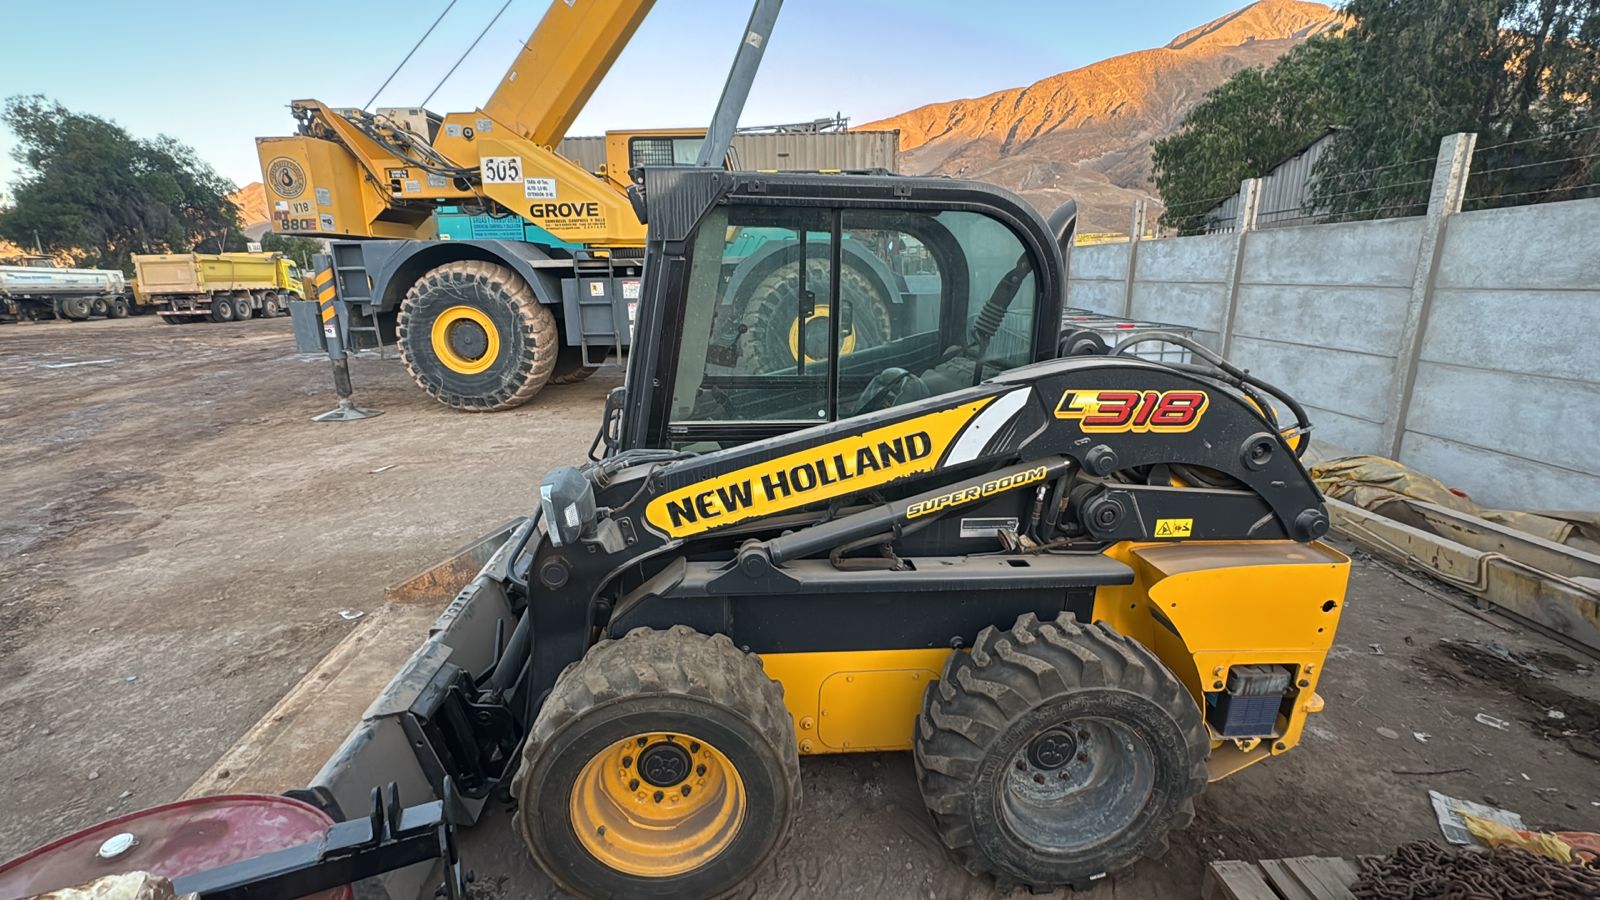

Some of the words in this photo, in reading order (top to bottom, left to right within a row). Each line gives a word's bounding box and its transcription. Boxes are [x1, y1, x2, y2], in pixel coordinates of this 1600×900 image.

[486, 159, 518, 181] 505
[293, 202, 309, 213] V18
[530, 203, 599, 217] GROVE
[282, 218, 316, 230] 880E
[1056, 391, 1208, 430] L318
[666, 480, 753, 528] NEW
[761, 431, 932, 500] HOLLAND
[908, 487, 980, 518] SUPER
[983, 467, 1047, 496] BOOM
